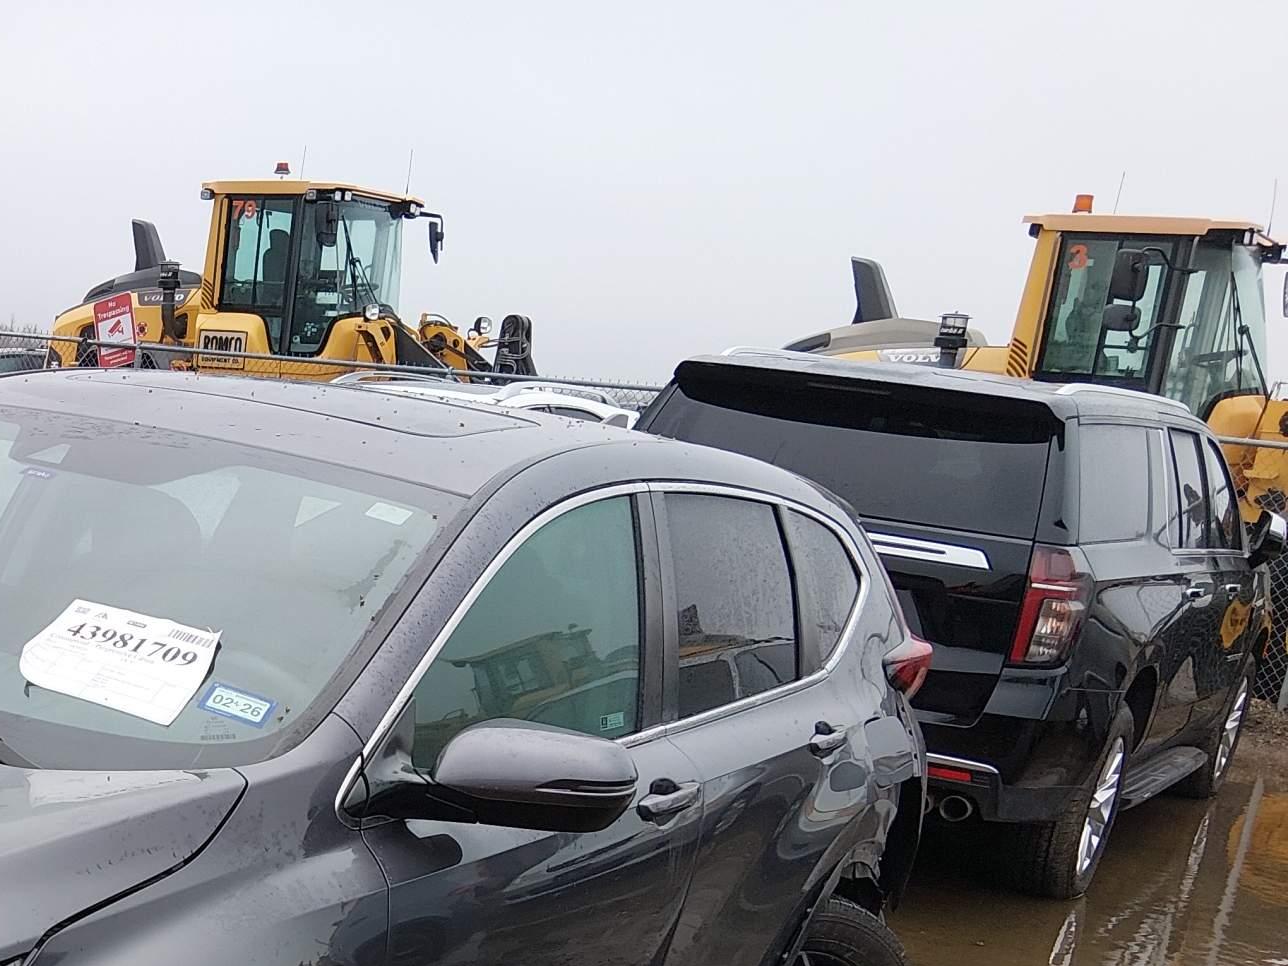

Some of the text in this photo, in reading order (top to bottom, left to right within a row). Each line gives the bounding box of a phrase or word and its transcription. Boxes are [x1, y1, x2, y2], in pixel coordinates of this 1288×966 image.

[232, 201, 256, 220] 79
[1068, 244, 1088, 269] 3
[97, 305, 130, 320] Trespassing
[203, 335, 242, 352] ROMCO
[67, 622, 199, 666] 43981709
